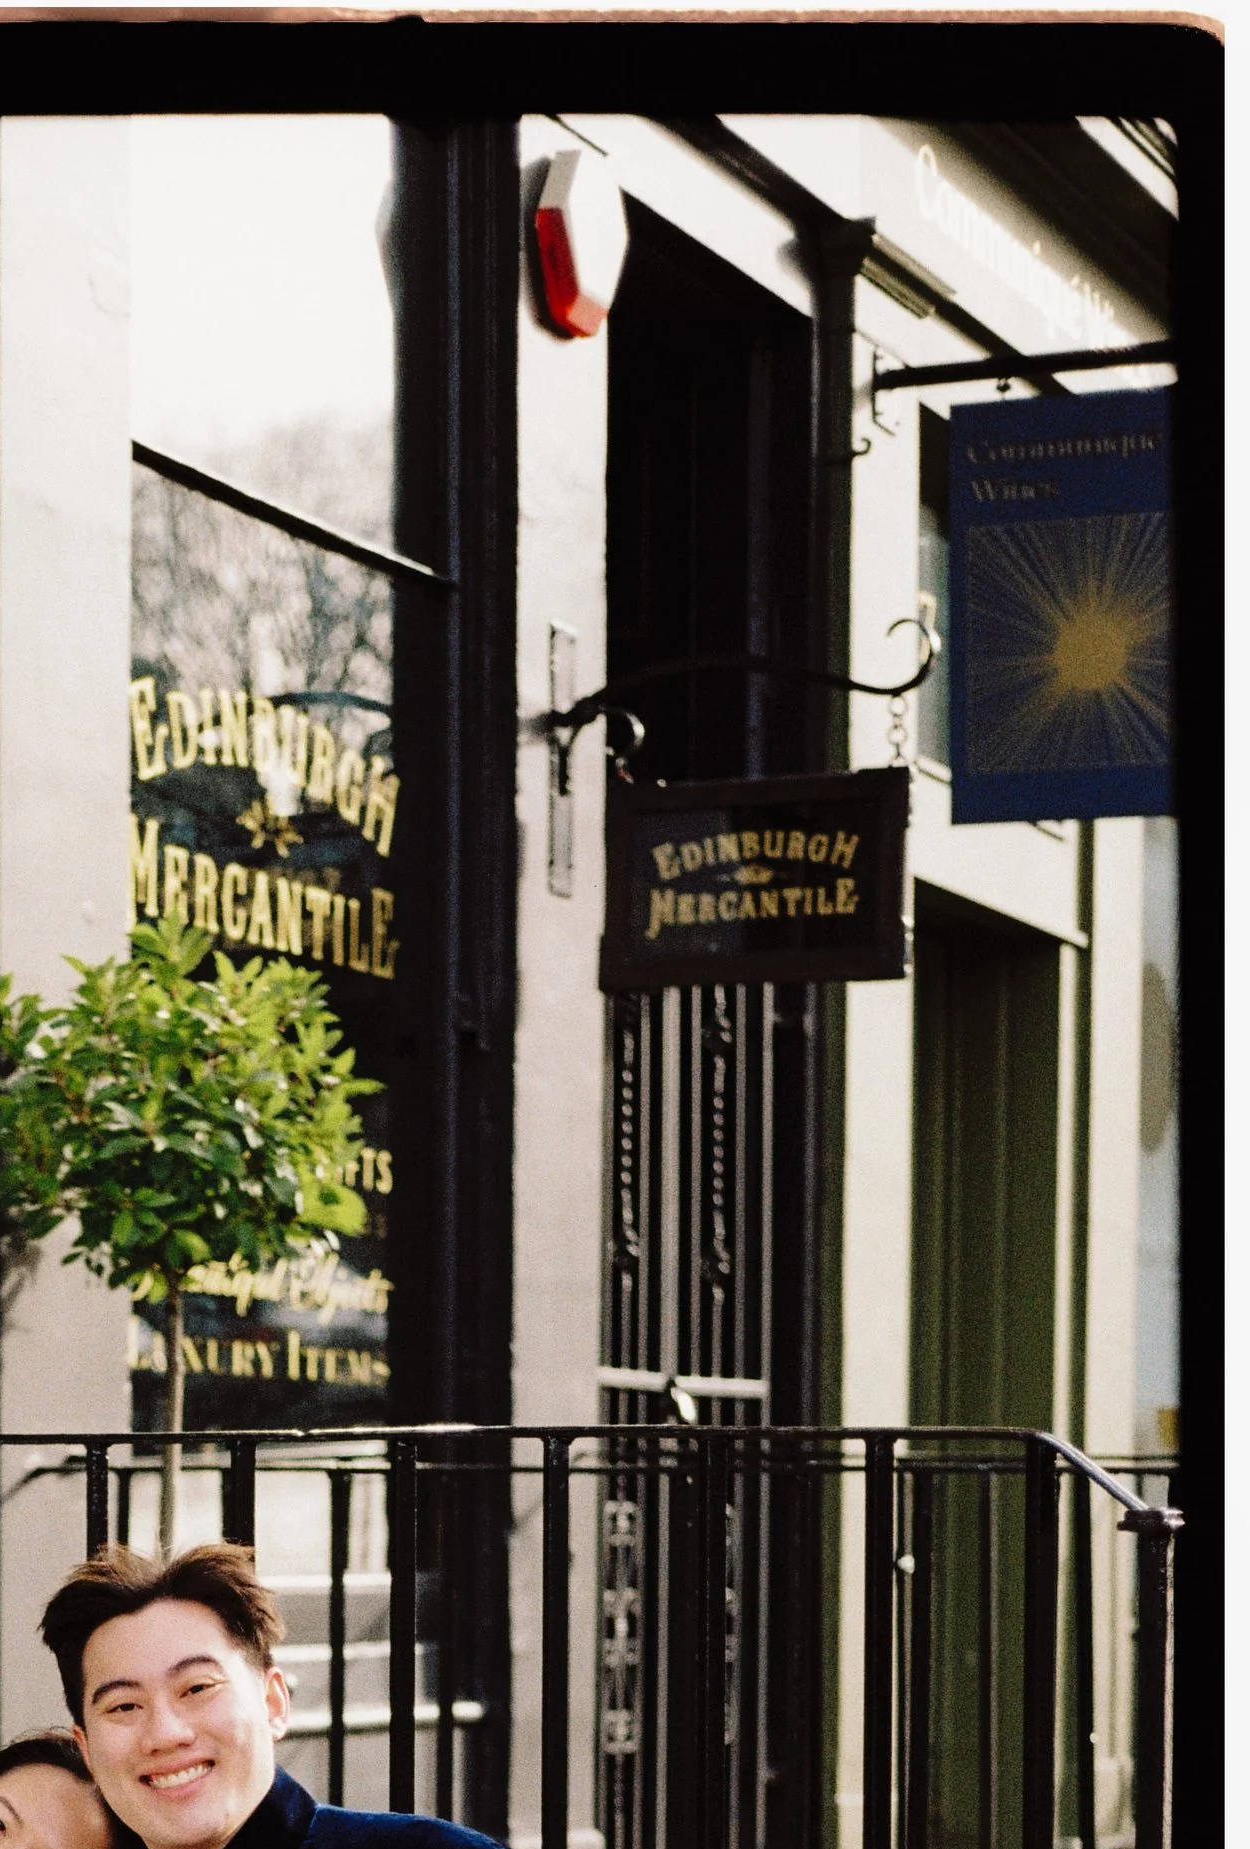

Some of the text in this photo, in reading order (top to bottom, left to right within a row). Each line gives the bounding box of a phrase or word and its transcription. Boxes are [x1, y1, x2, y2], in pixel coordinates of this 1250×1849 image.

[129, 676, 401, 858] EDINBURGH
[652, 829, 860, 882] EDINBURGH
[129, 813, 400, 980] MERCANTILE
[645, 877, 860, 940] MERCANTILE
[287, 1329, 392, 1387] ITEMS
